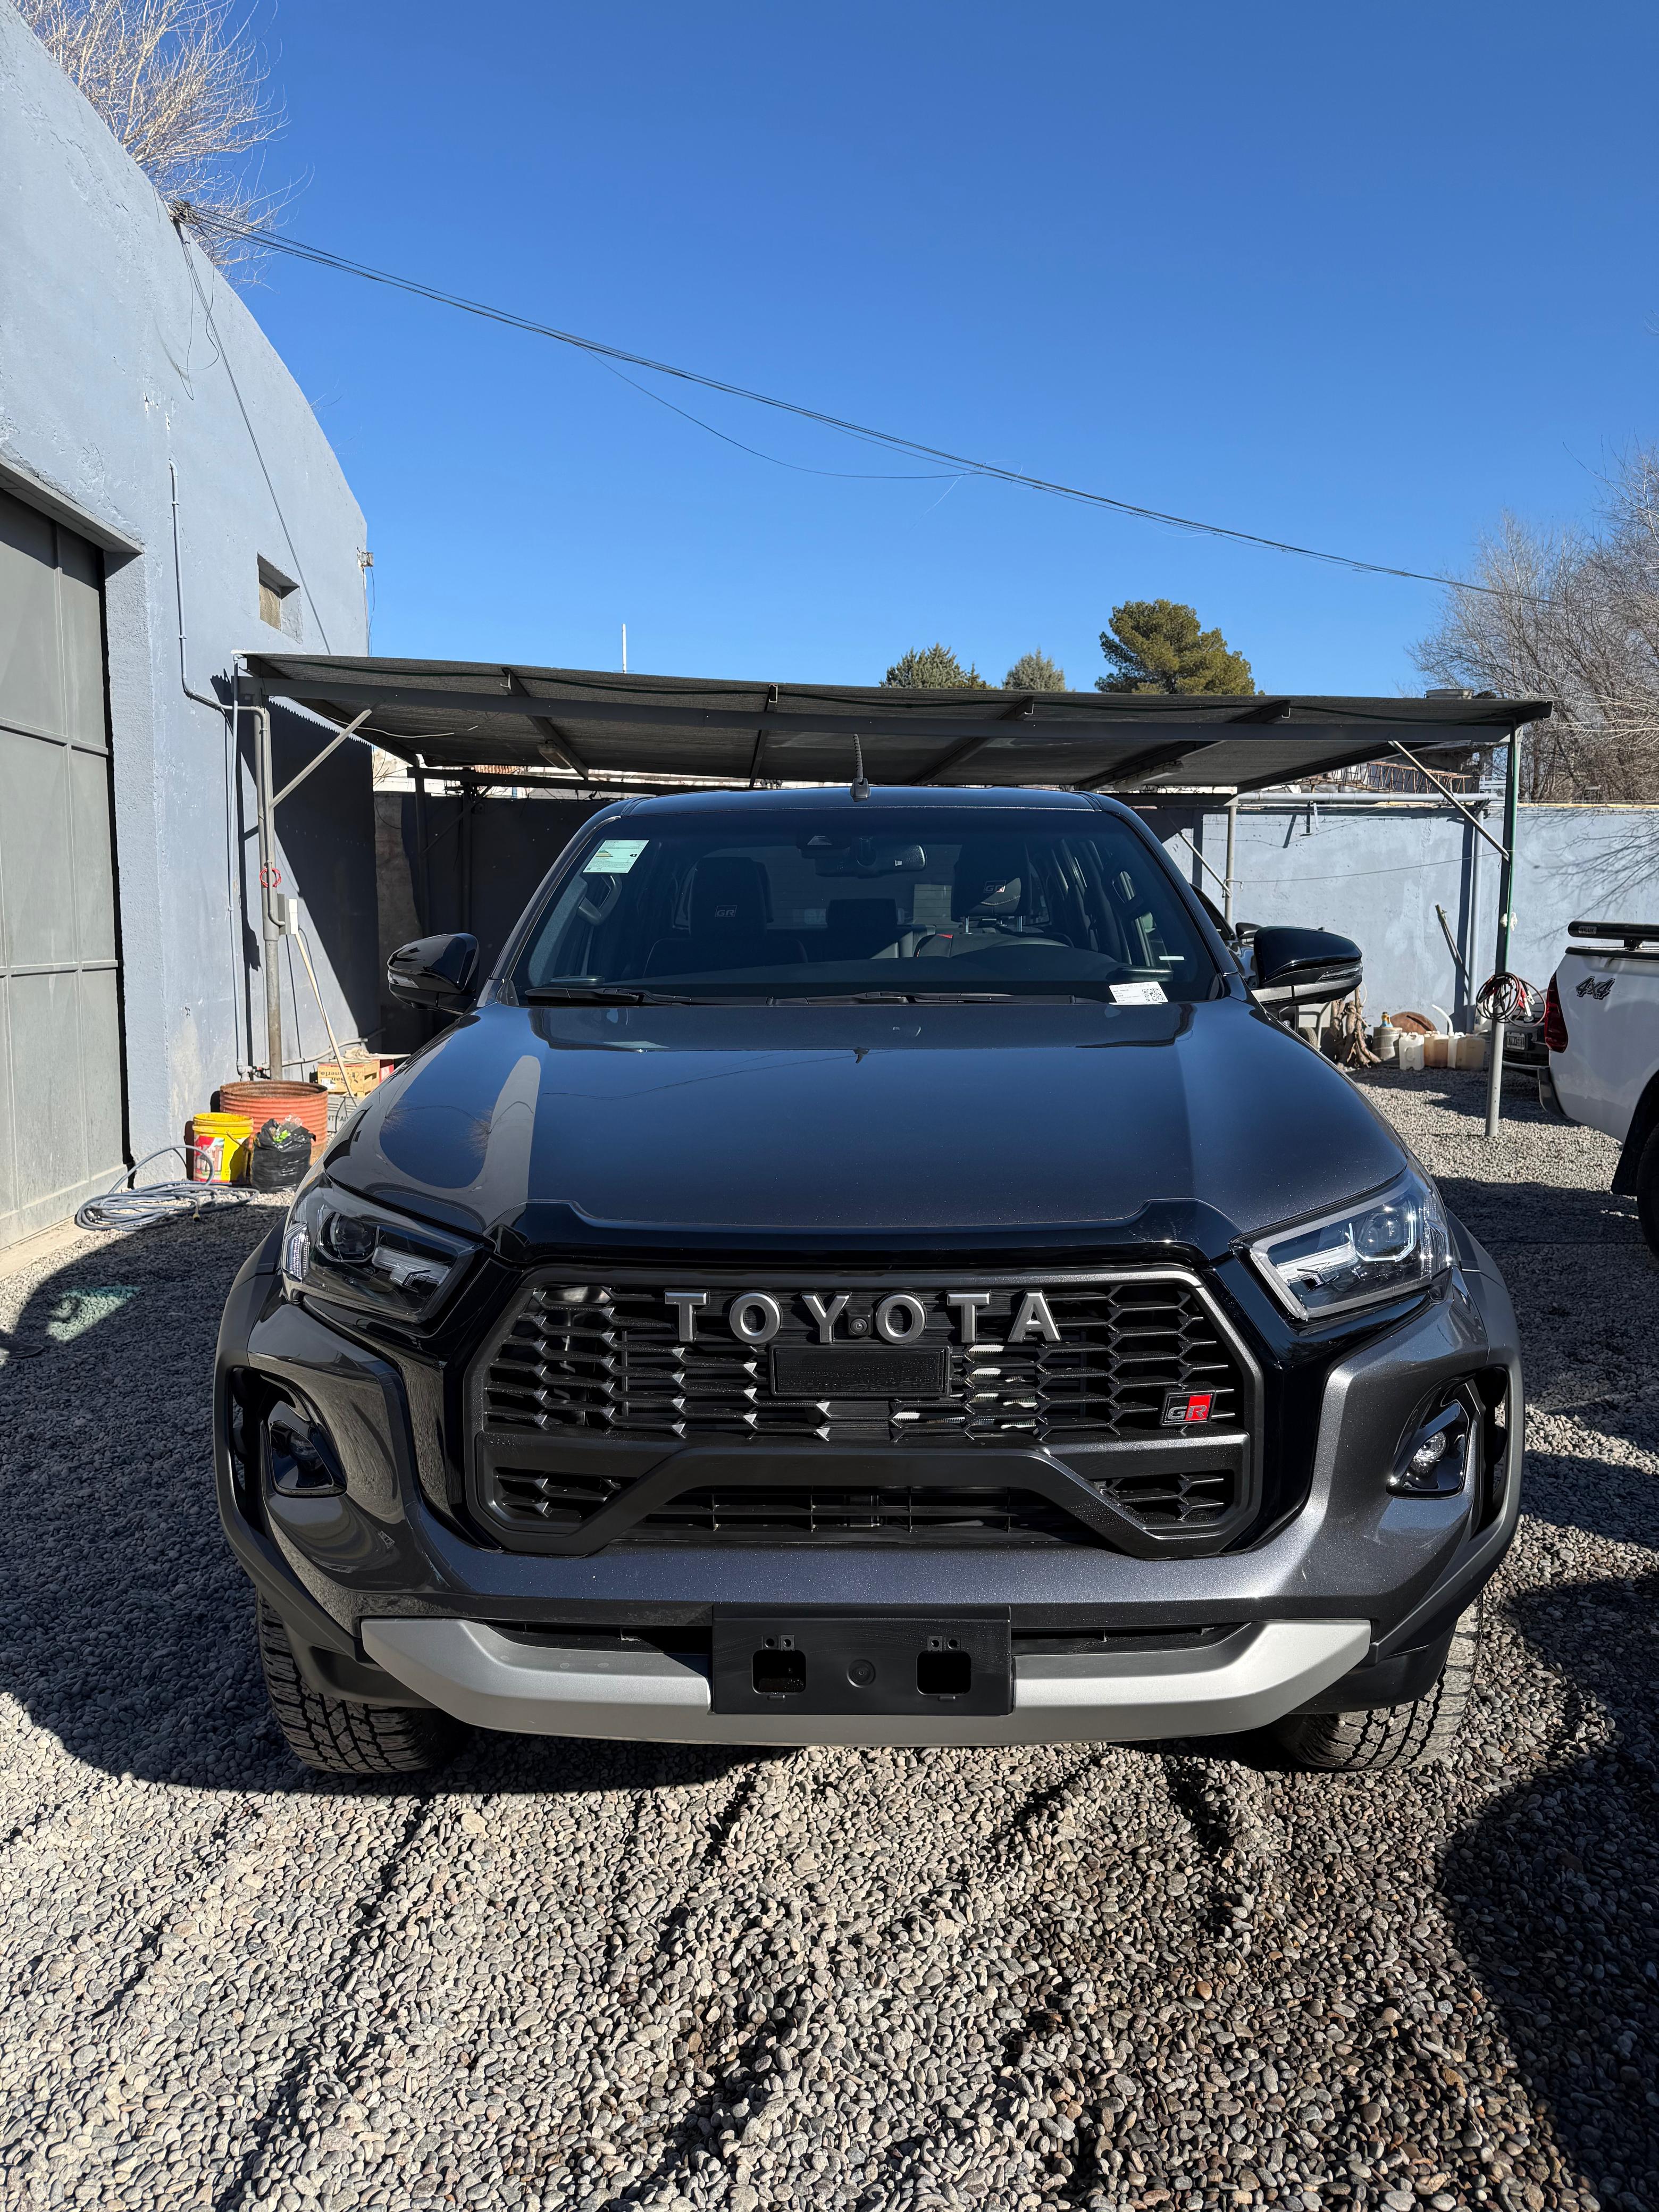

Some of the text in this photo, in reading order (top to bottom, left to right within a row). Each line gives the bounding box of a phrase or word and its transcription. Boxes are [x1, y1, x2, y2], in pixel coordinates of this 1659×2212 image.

[1576, 976, 1615, 1000] 4x4
[665, 1289, 1061, 1345] TOYOTA
[1167, 1405, 1208, 1420] GR
